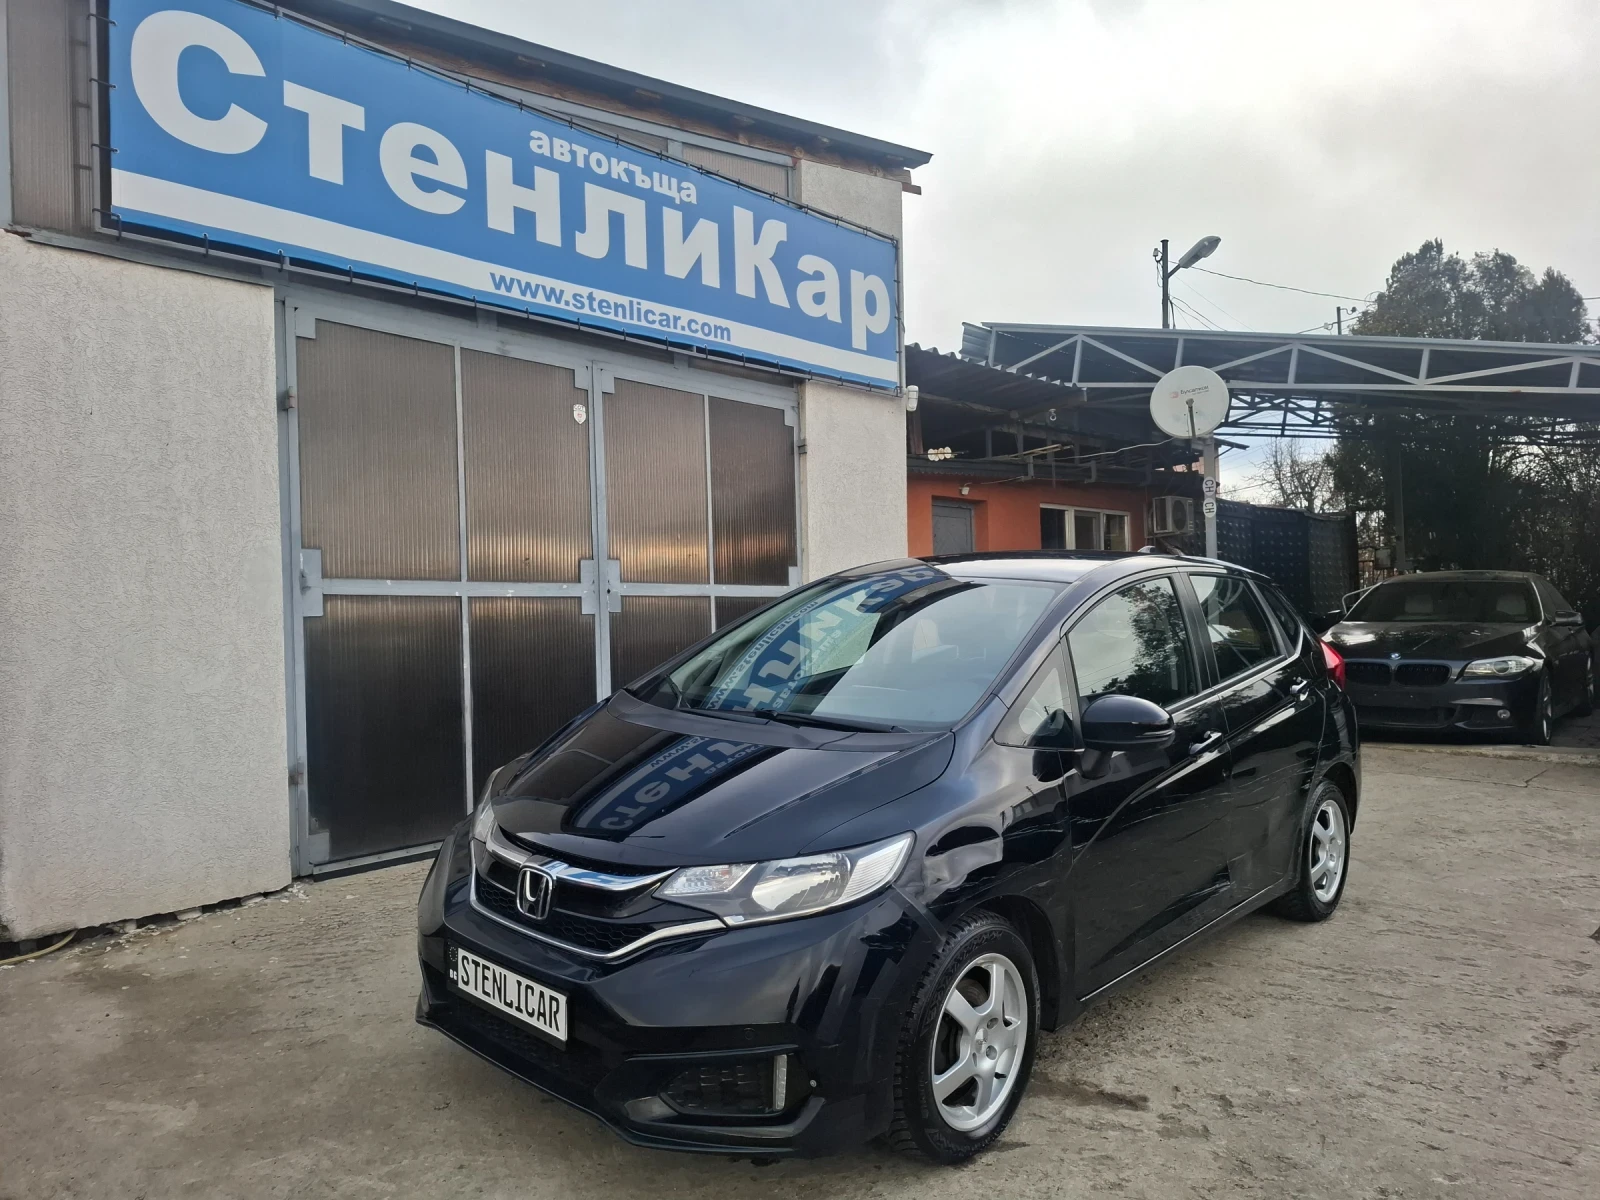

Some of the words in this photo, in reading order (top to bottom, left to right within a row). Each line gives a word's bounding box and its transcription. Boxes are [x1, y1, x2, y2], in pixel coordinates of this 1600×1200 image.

[130, 9, 892, 351] СтенлиКар
[529, 130, 698, 205] автокъща
[489, 271, 732, 342] www.stenlicar.com
[1204, 479, 1215, 493] CH
[1204, 501, 1215, 514] CH
[460, 955, 560, 1032] STENLICAR
